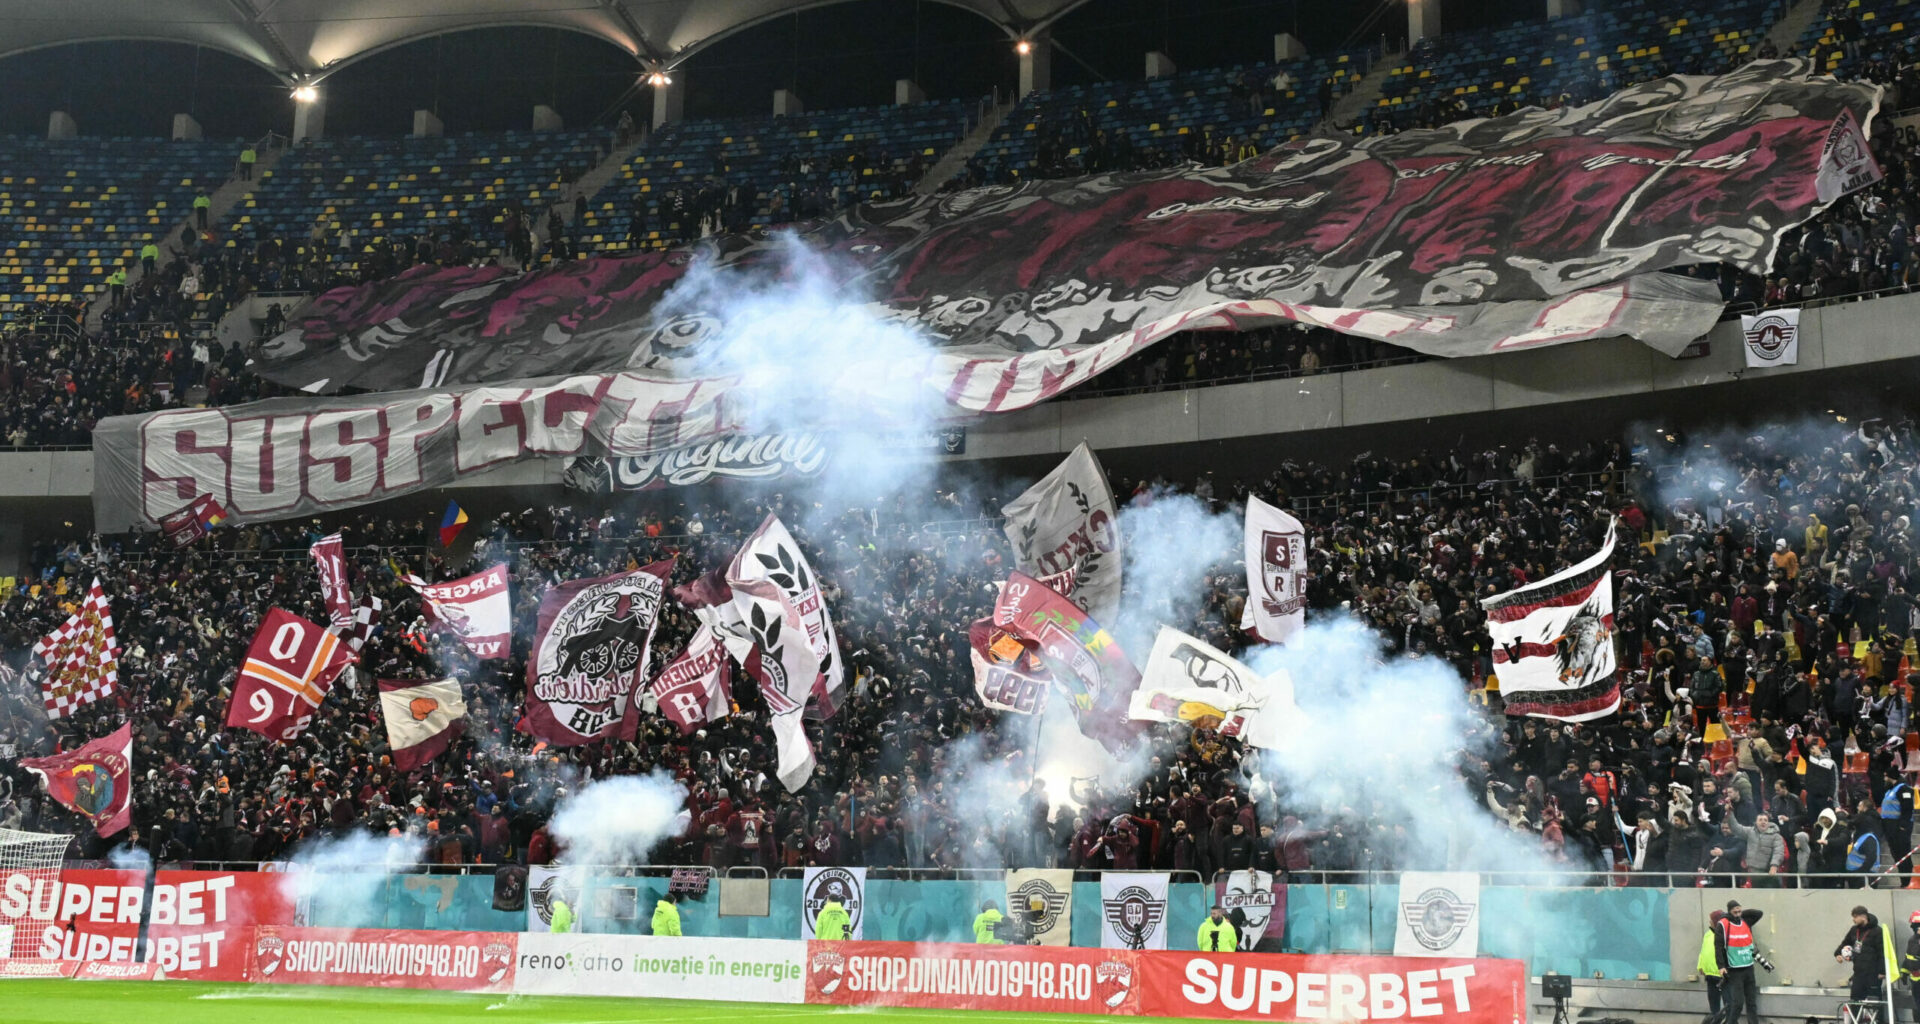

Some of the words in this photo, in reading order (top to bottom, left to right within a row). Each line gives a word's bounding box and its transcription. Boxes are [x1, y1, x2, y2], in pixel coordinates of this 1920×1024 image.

[4, 873, 235, 926] SUPERBET
[1225, 893, 1273, 906] CAPITALI
[86, 962, 147, 976] SUPERLIGA
[286, 942, 479, 978] SHOP.DINAMO1948.RO
[633, 954, 704, 981] inovație
[708, 955, 725, 975] în
[730, 959, 801, 983] energie
[848, 956, 1091, 1000] SHOP.DINAMO1948.RO
[1181, 957, 1476, 1020] SUPERBET
